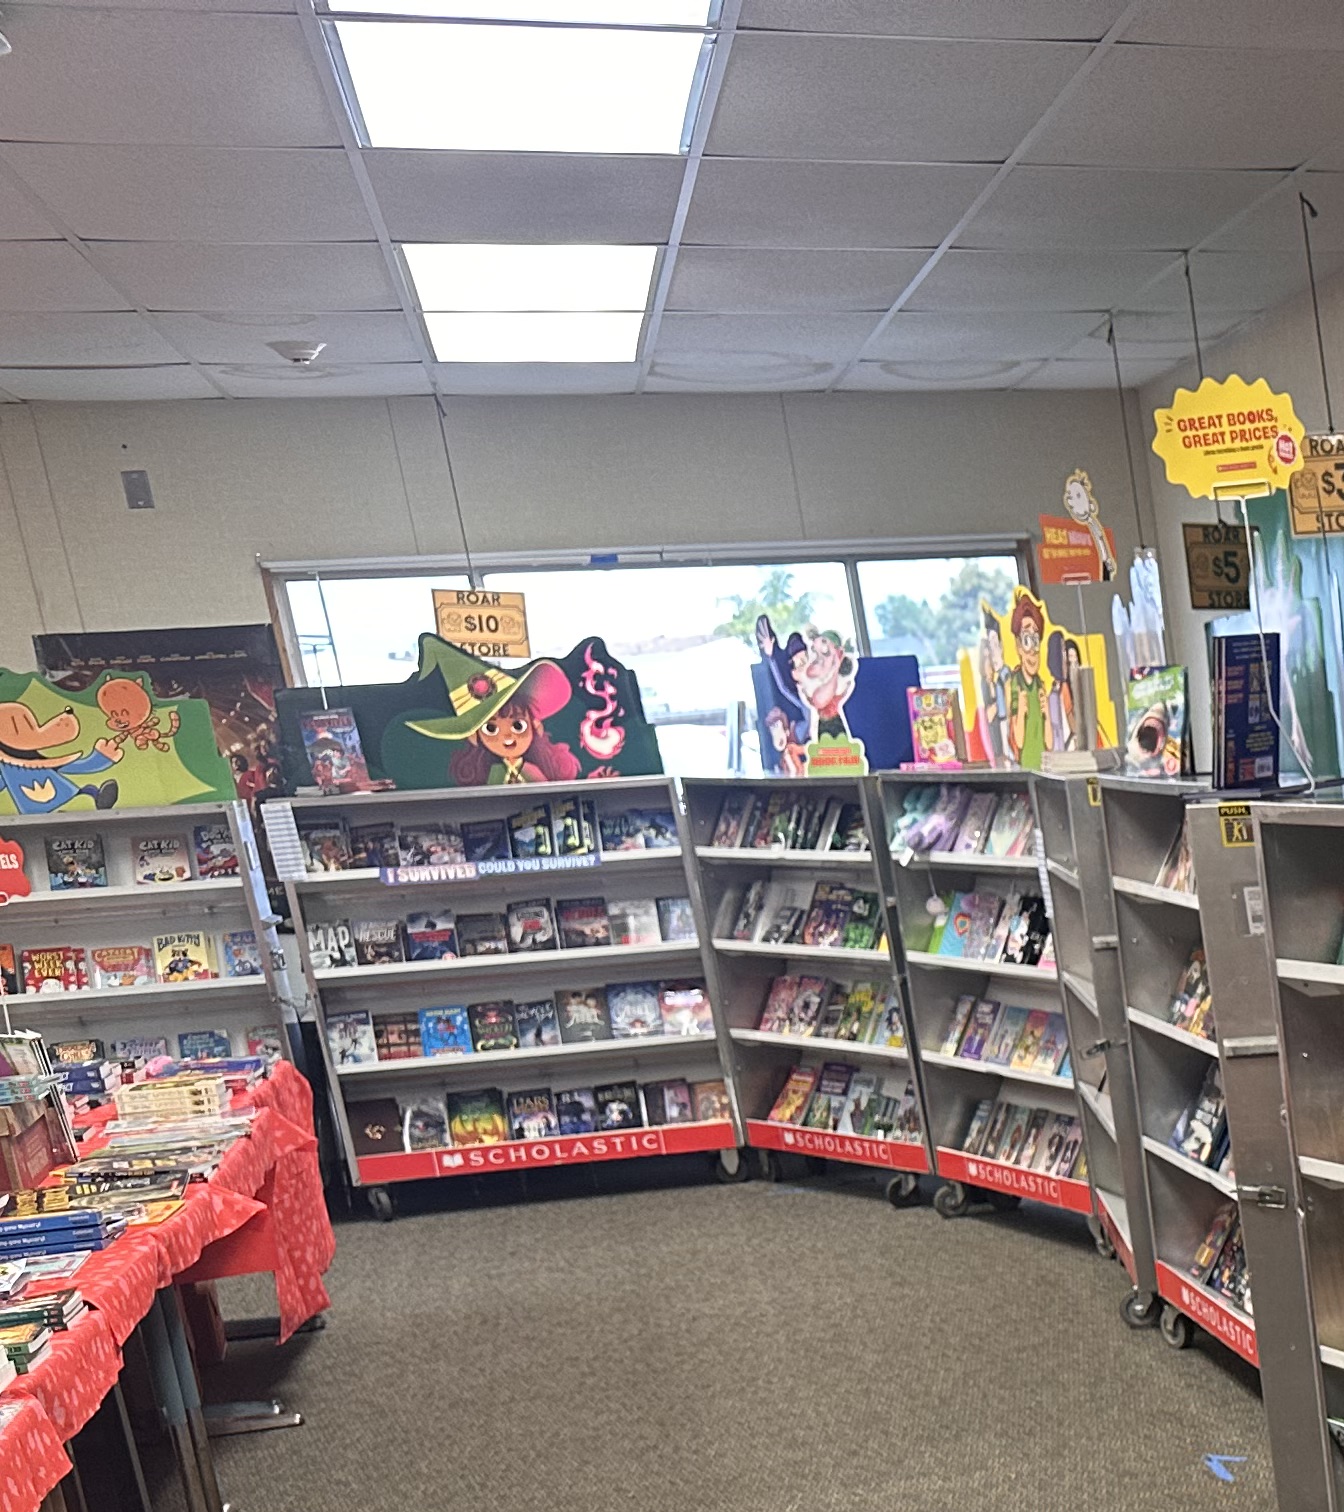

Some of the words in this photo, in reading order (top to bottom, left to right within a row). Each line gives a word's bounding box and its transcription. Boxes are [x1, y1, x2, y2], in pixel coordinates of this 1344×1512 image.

[1177, 414, 1223, 432] GREAT
[1227, 408, 1279, 426] BOOKS,
[1182, 431, 1226, 449] GREAT
[1230, 425, 1279, 444] PRICES
[1202, 526, 1241, 544] ROAR
[1212, 551, 1241, 584] $5
[457, 591, 500, 605] ROAR
[464, 614, 499, 633] $10
[52, 840, 72, 850] CAT
[75, 840, 95, 849] KID
[139, 840, 160, 850] CAT
[161, 839, 180, 849] KID
[386, 868, 395, 883] I
[398, 864, 476, 882] SURVIVED
[479, 861, 515, 873] COULD
[517, 859, 540, 870] YOU
[542, 854, 596, 869] SURVIVE?
[156, 936, 175, 952] BAD
[177, 934, 200, 946] KITTY
[308, 923, 349, 951] MAP
[470, 1133, 660, 1168] SCHOLASTIC
[795, 1134, 888, 1160] SCHOLASTIC
[978, 1164, 1058, 1198] SCHOLASTIC
[1190, 1290, 1255, 1355] SCHOLASTIC
